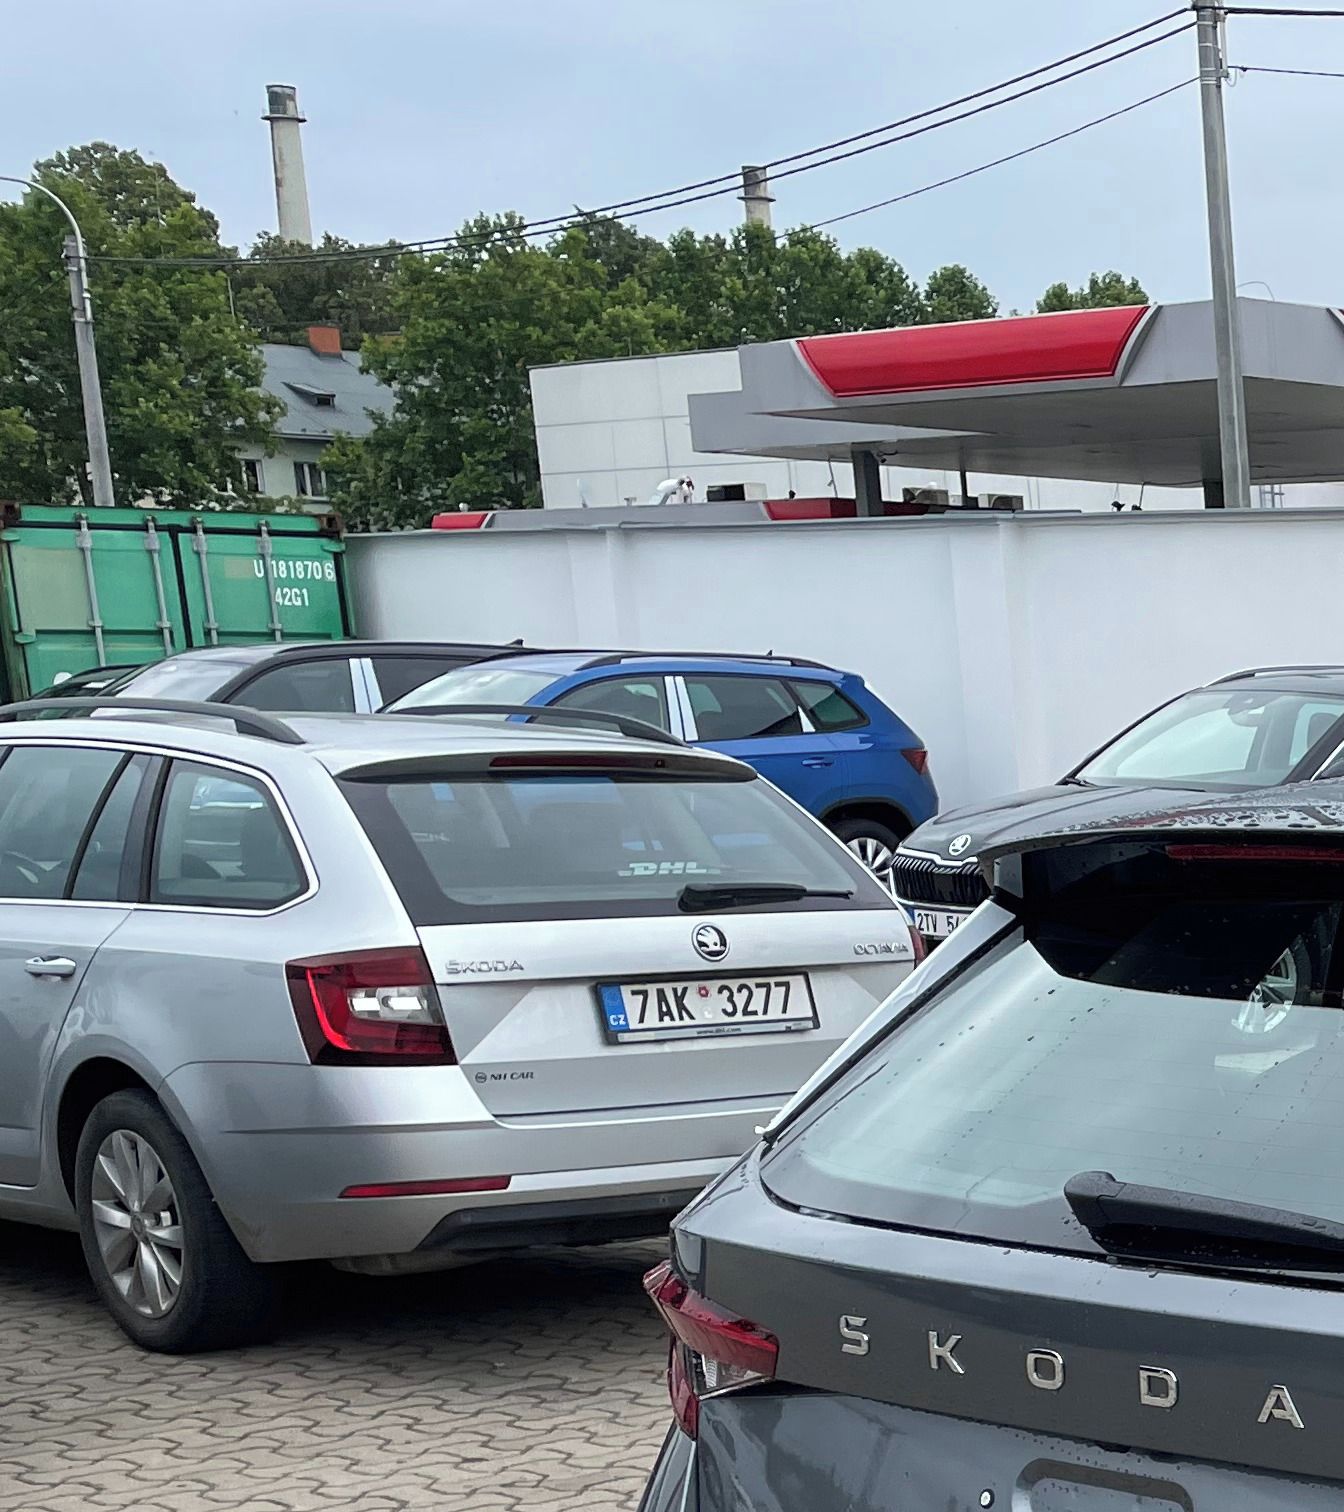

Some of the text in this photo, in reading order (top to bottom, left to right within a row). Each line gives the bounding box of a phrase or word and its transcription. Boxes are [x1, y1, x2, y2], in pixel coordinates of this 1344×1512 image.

[276, 588, 309, 606] 42G1
[628, 861, 707, 876] DHL
[917, 912, 937, 933] 2TV
[853, 943, 909, 956] OCTAVIA
[630, 981, 791, 1024] 7AK 3277
[609, 1014, 626, 1026] CZ
